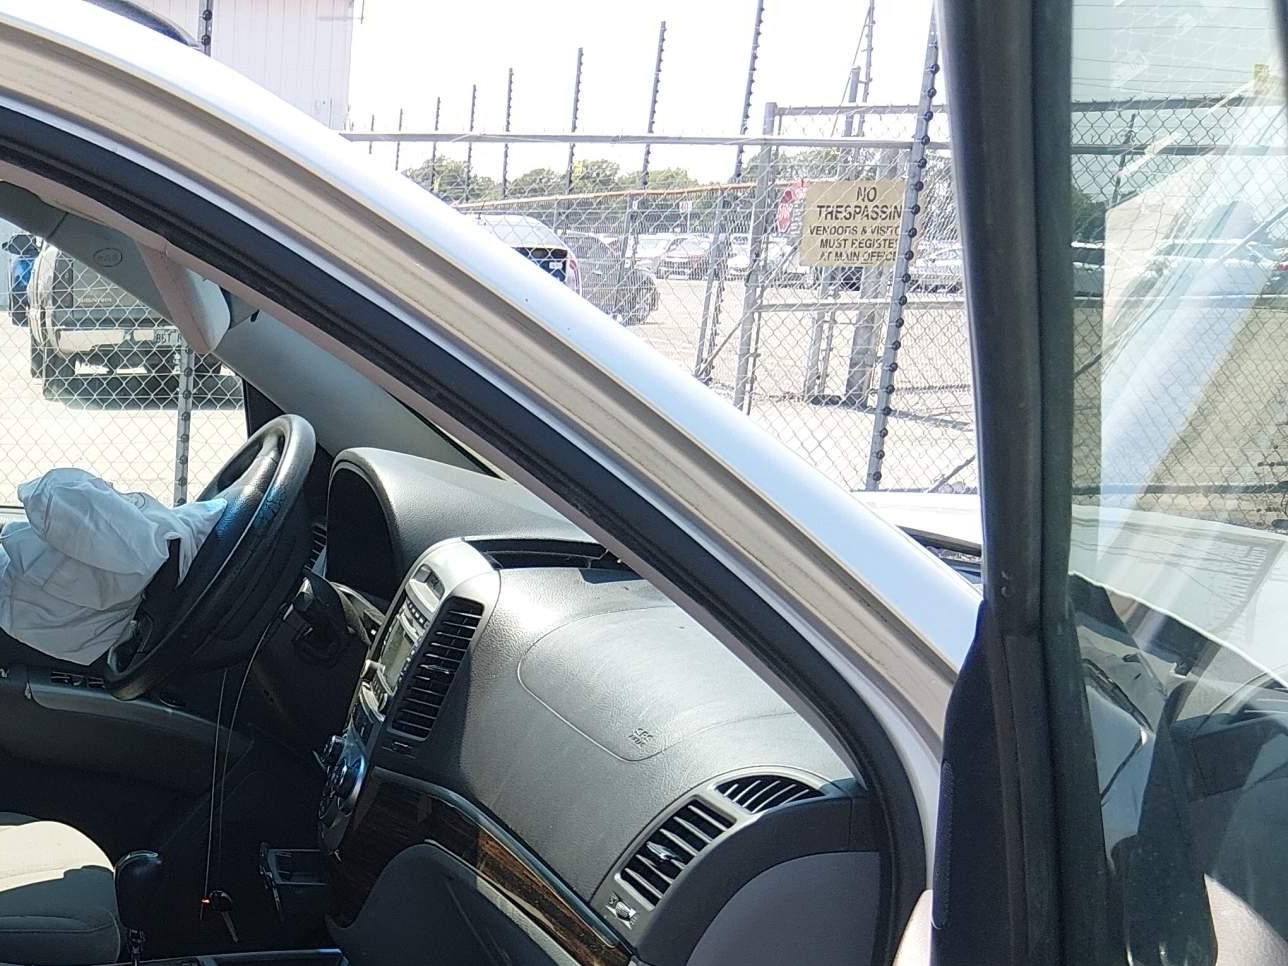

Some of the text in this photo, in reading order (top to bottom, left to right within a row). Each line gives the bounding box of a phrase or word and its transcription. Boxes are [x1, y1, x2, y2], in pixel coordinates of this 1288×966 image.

[856, 187, 877, 202] NO
[817, 205, 902, 220] TRESPASSIN
[809, 225, 858, 235] VENDORS
[820, 239, 849, 249] MUST
[819, 251, 833, 262] AT
[834, 251, 860, 262] MAIN
